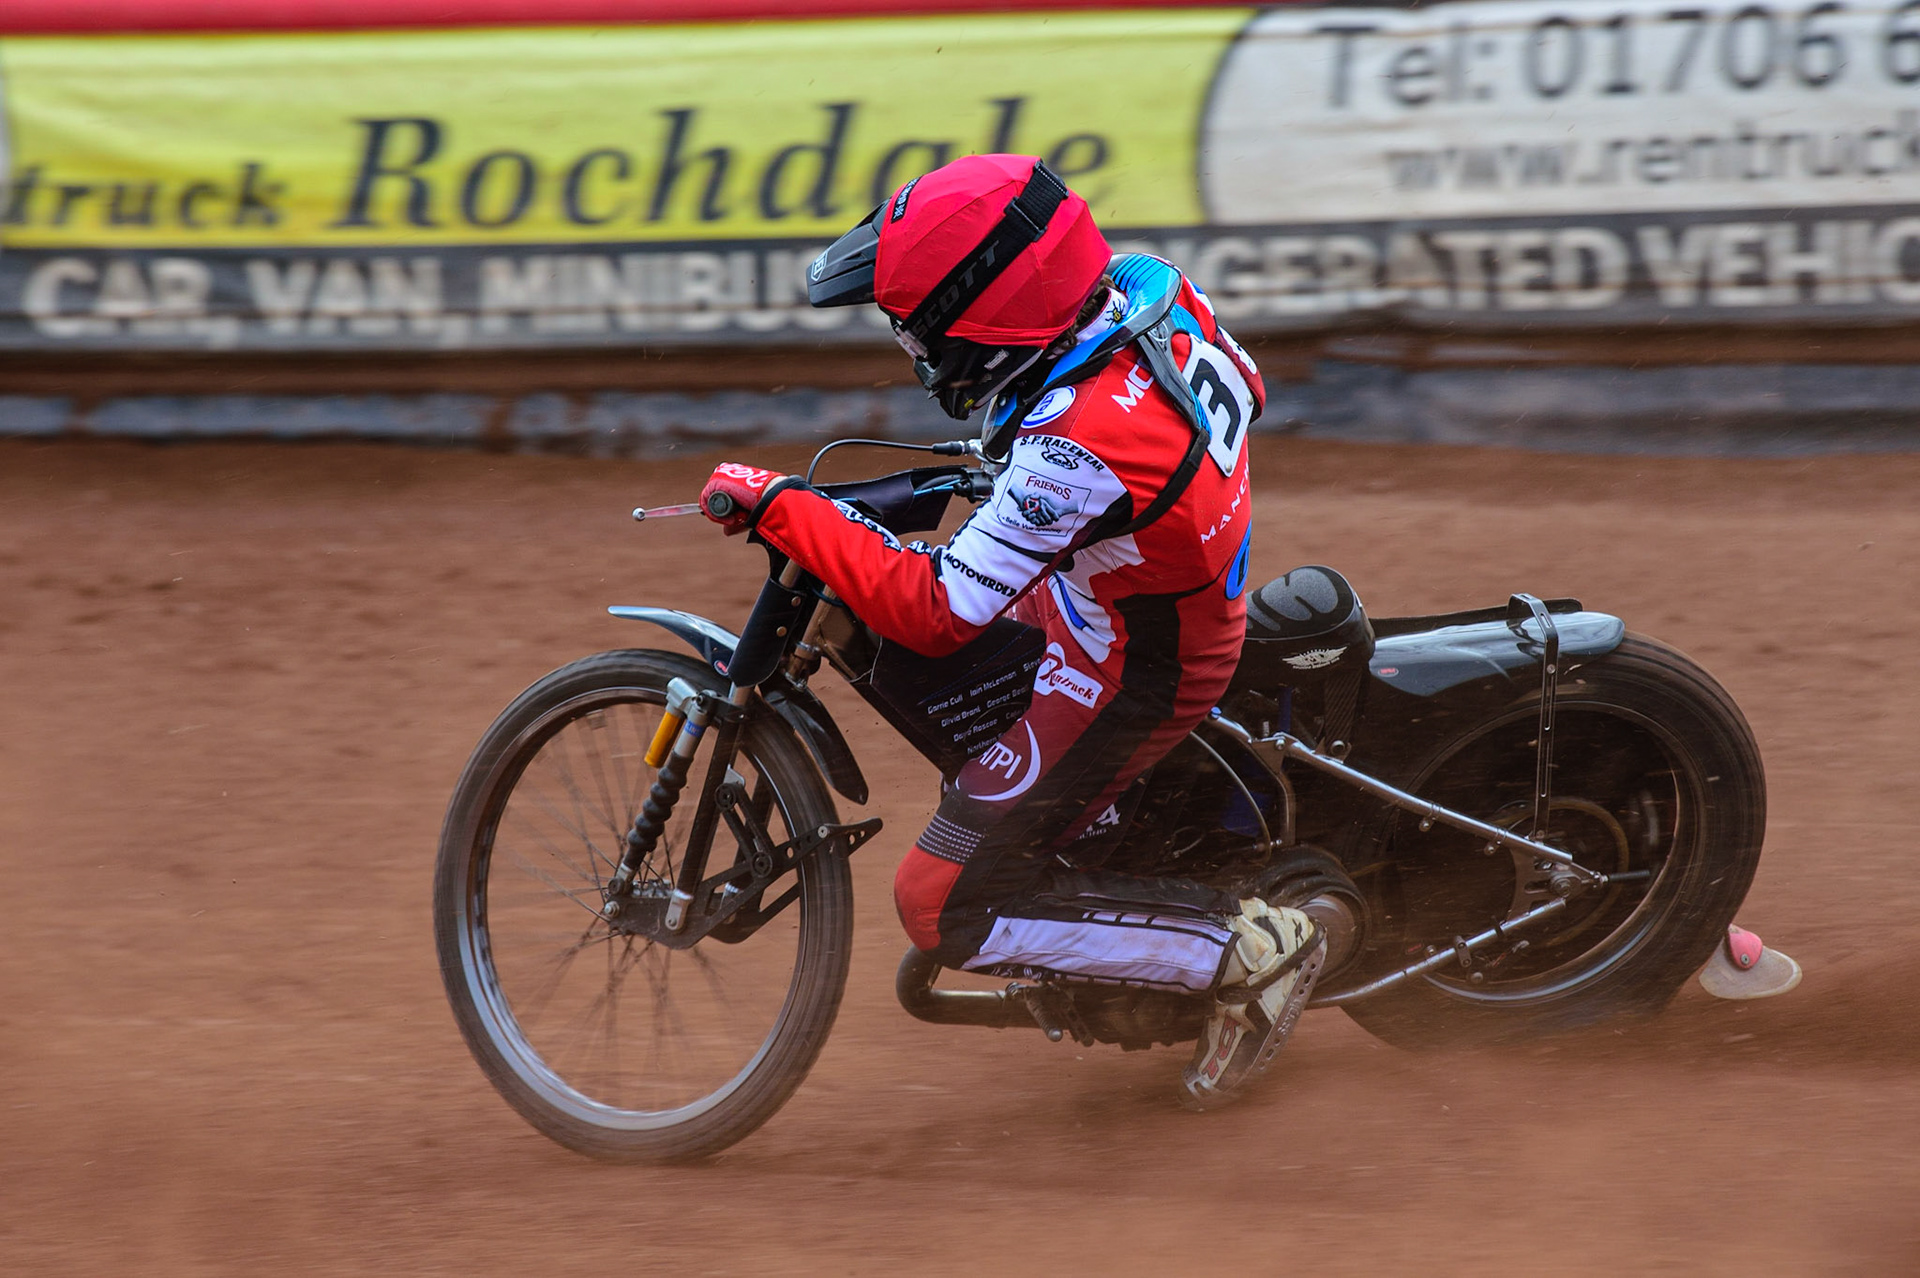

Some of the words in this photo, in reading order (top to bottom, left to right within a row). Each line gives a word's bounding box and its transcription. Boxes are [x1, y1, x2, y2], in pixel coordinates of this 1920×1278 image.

[1315, 22, 1497, 108] Tel:
[1524, 2, 1847, 100] 01706
[913, 239, 1000, 340] SCOTT
[1190, 357, 1241, 452] 3
